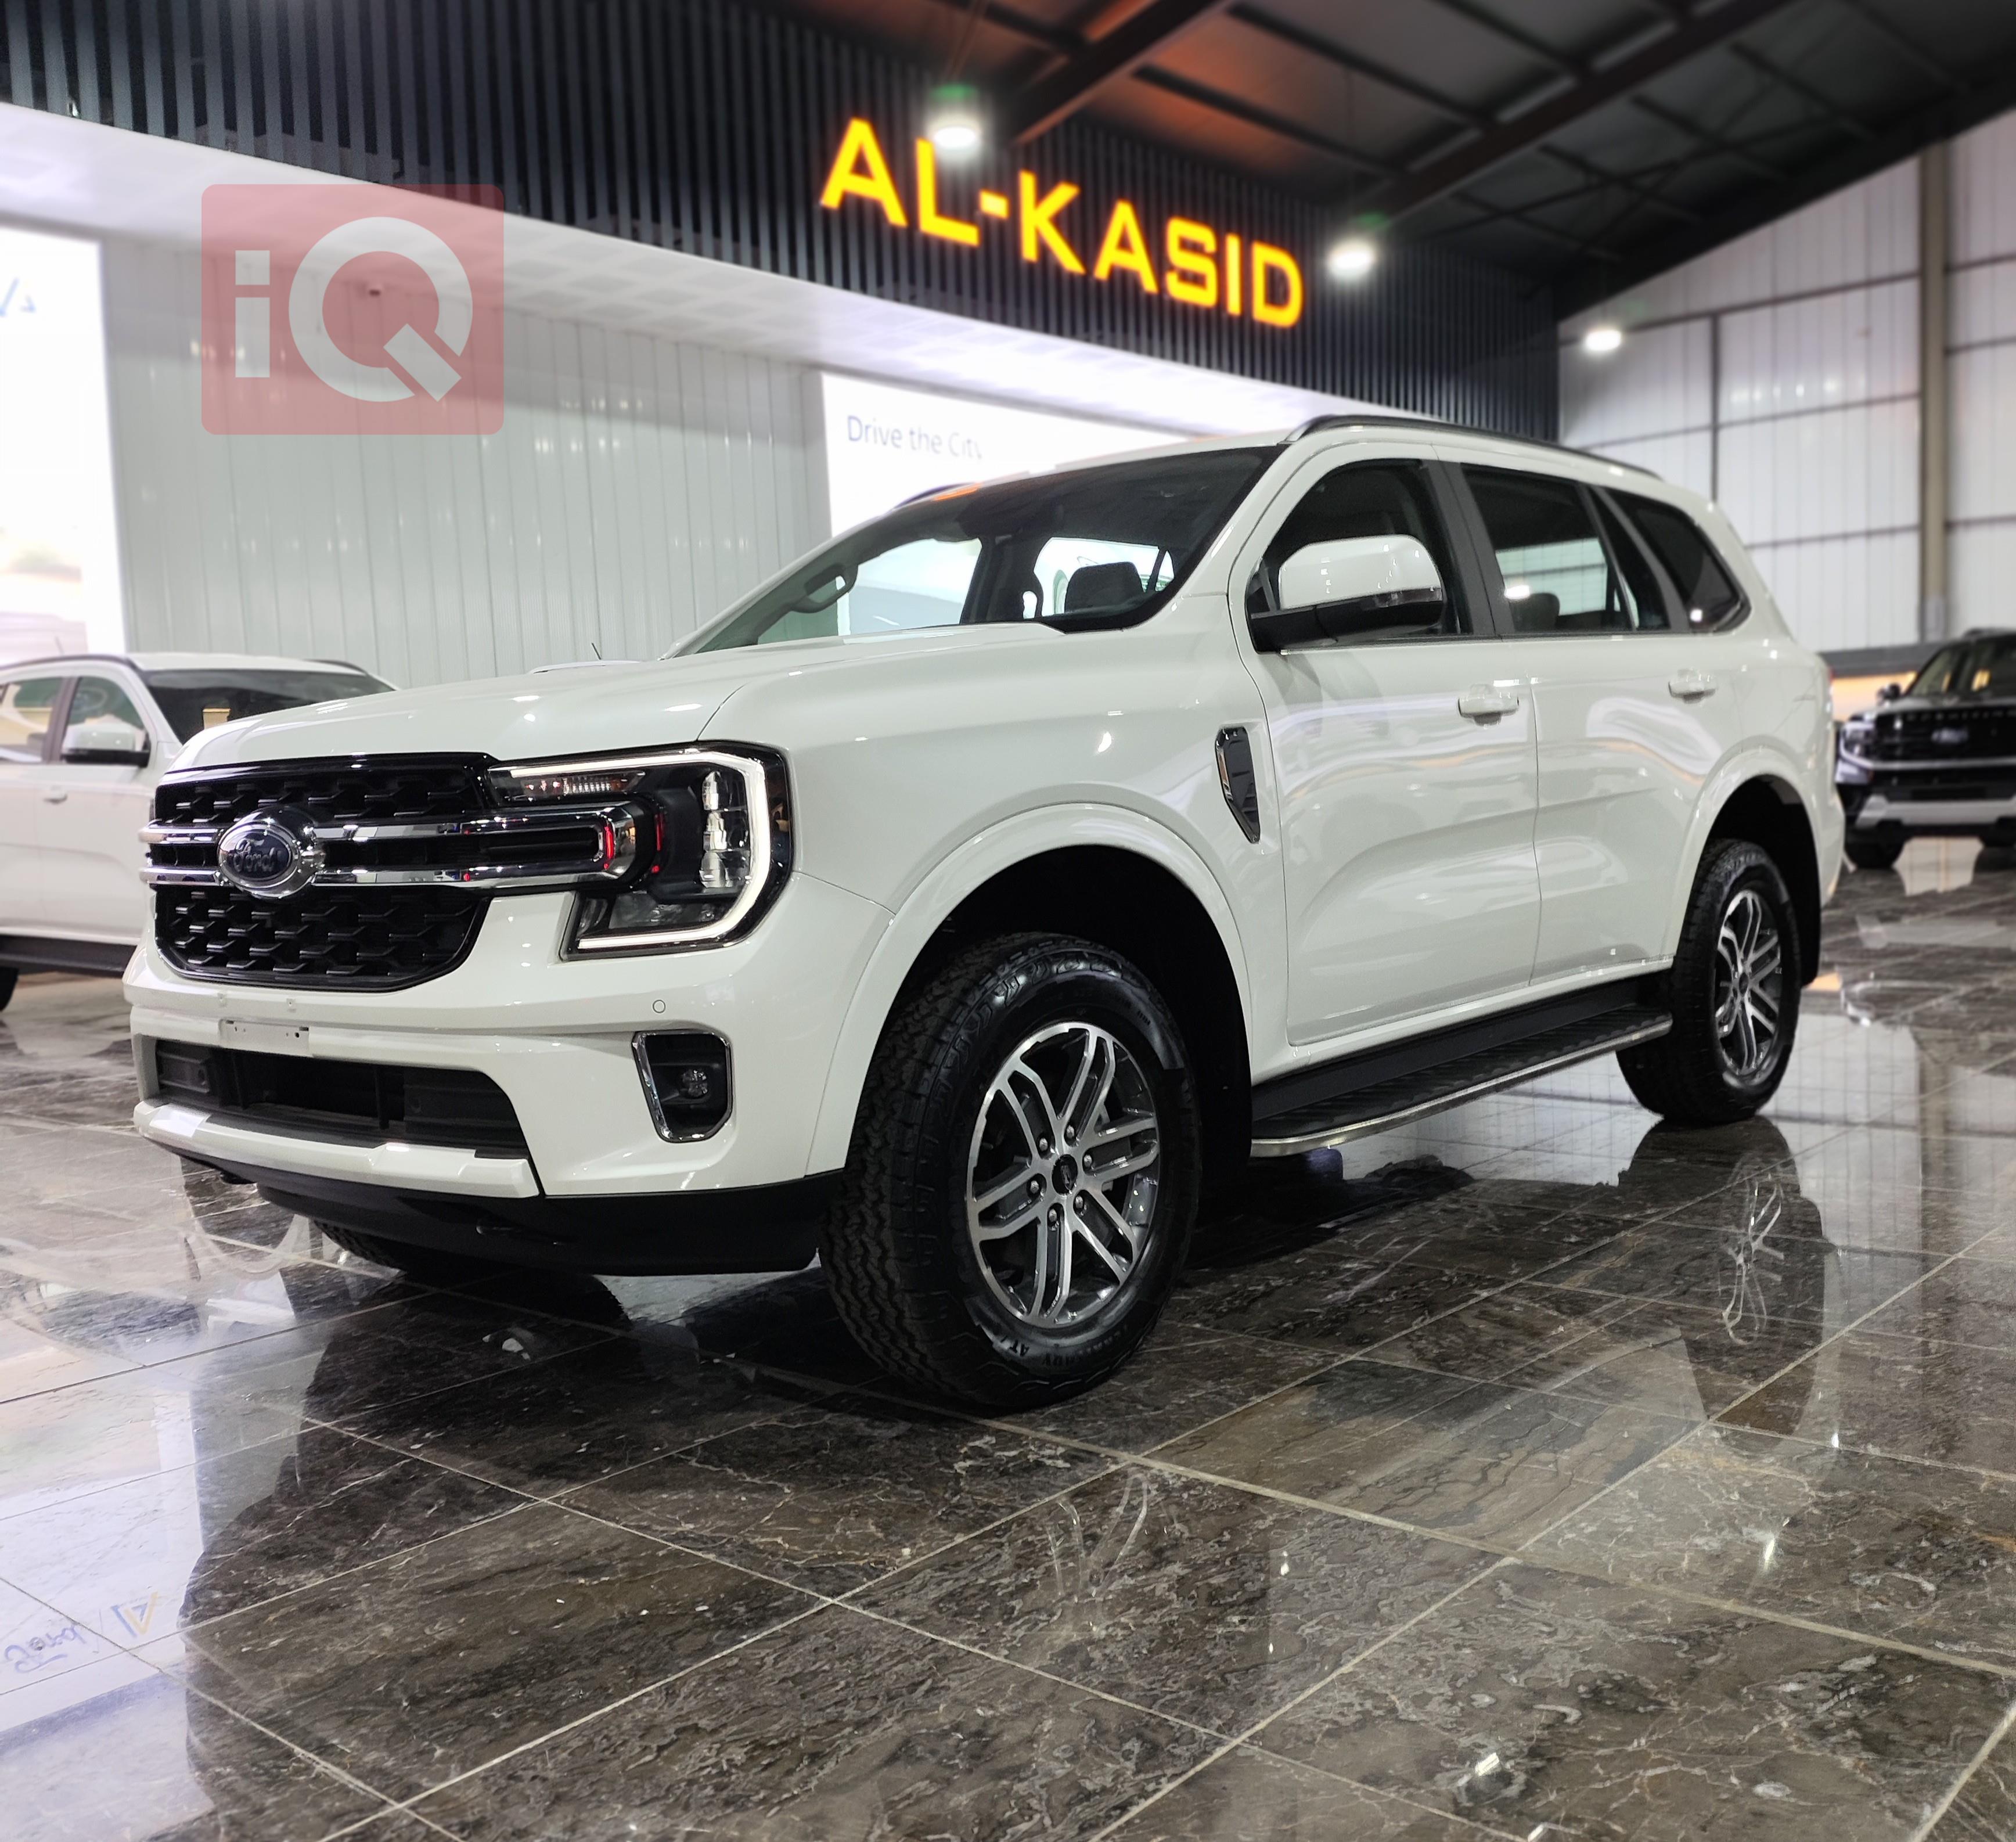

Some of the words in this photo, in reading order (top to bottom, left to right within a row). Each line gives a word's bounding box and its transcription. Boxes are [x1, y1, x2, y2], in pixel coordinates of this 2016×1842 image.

[819, 117, 1304, 328] AL-KASID
[847, 414, 903, 449] Drive
[909, 425, 943, 454] the
[233, 837, 276, 872] Ford
